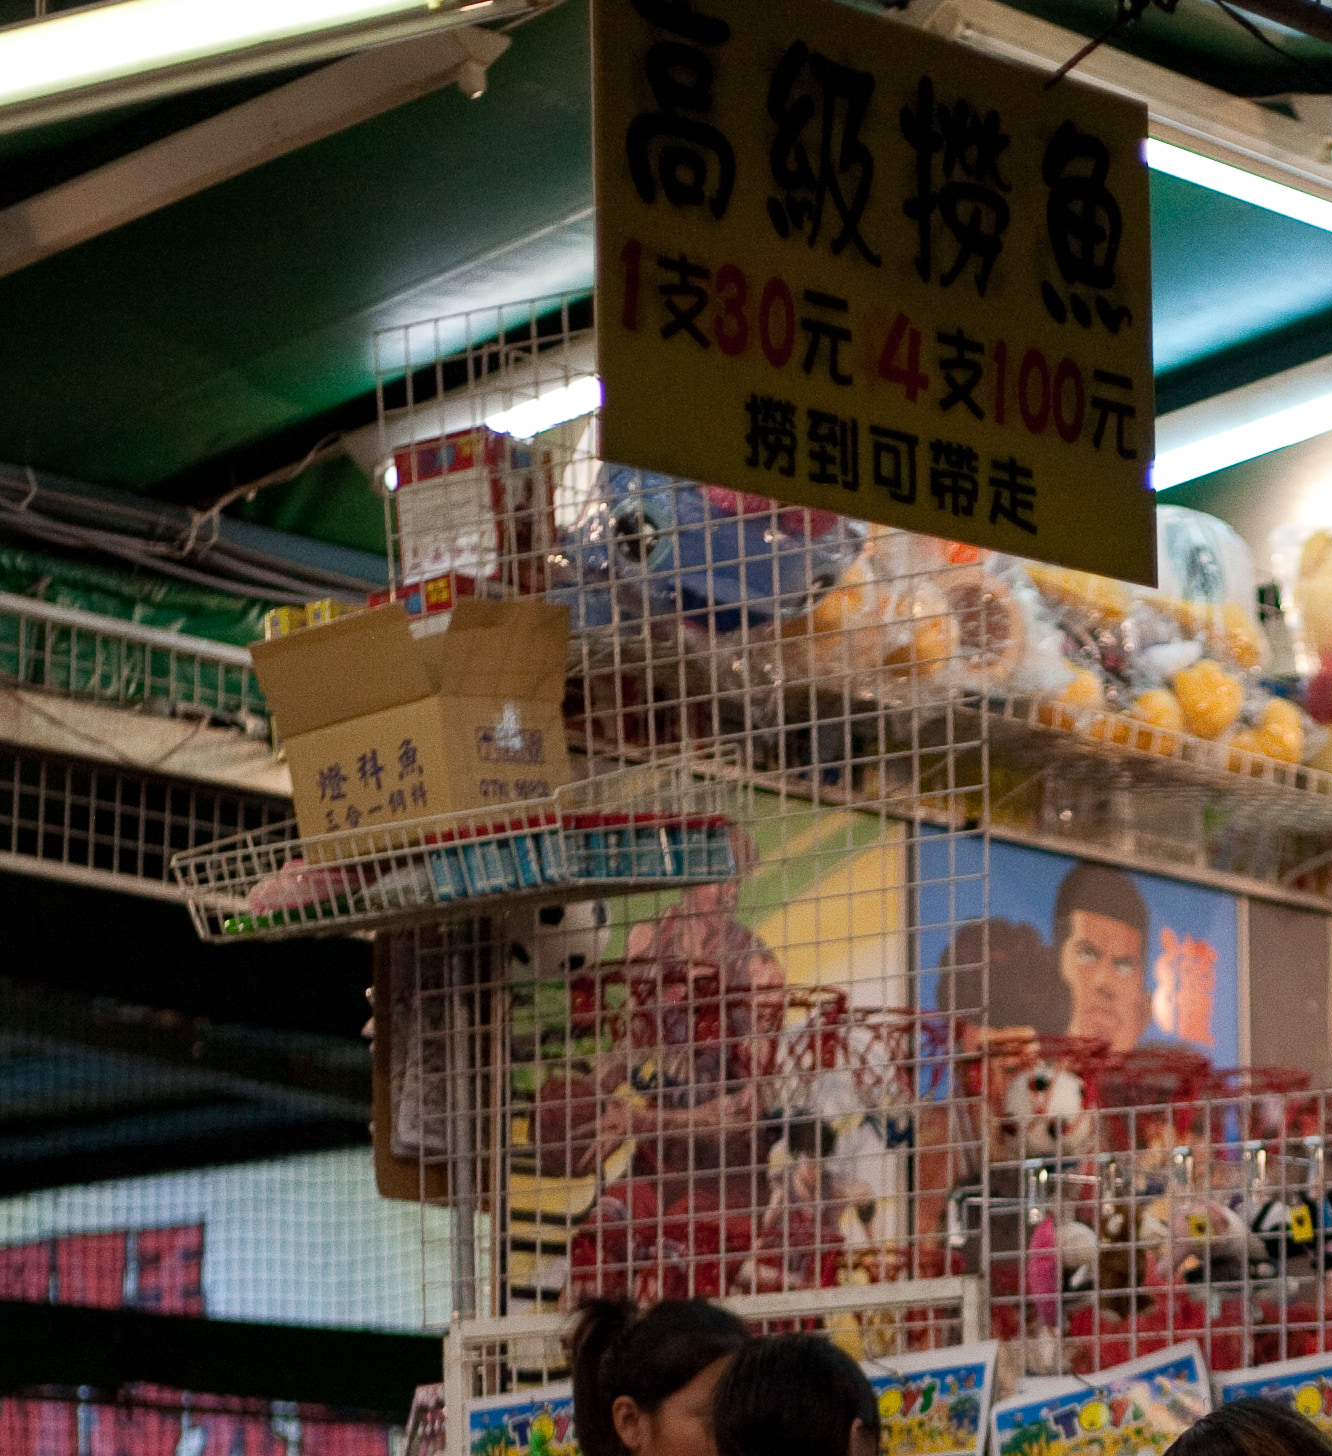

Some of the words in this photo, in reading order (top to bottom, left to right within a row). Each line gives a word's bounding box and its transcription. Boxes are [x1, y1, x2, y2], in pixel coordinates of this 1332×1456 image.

[625, 0, 1133, 334] 高級撈魚
[619, 237, 854, 387] 1支30元
[877, 312, 1138, 460] 4支100元
[743, 393, 1039, 535] 撈到可帶走
[511, 1412, 572, 1447] TOY
